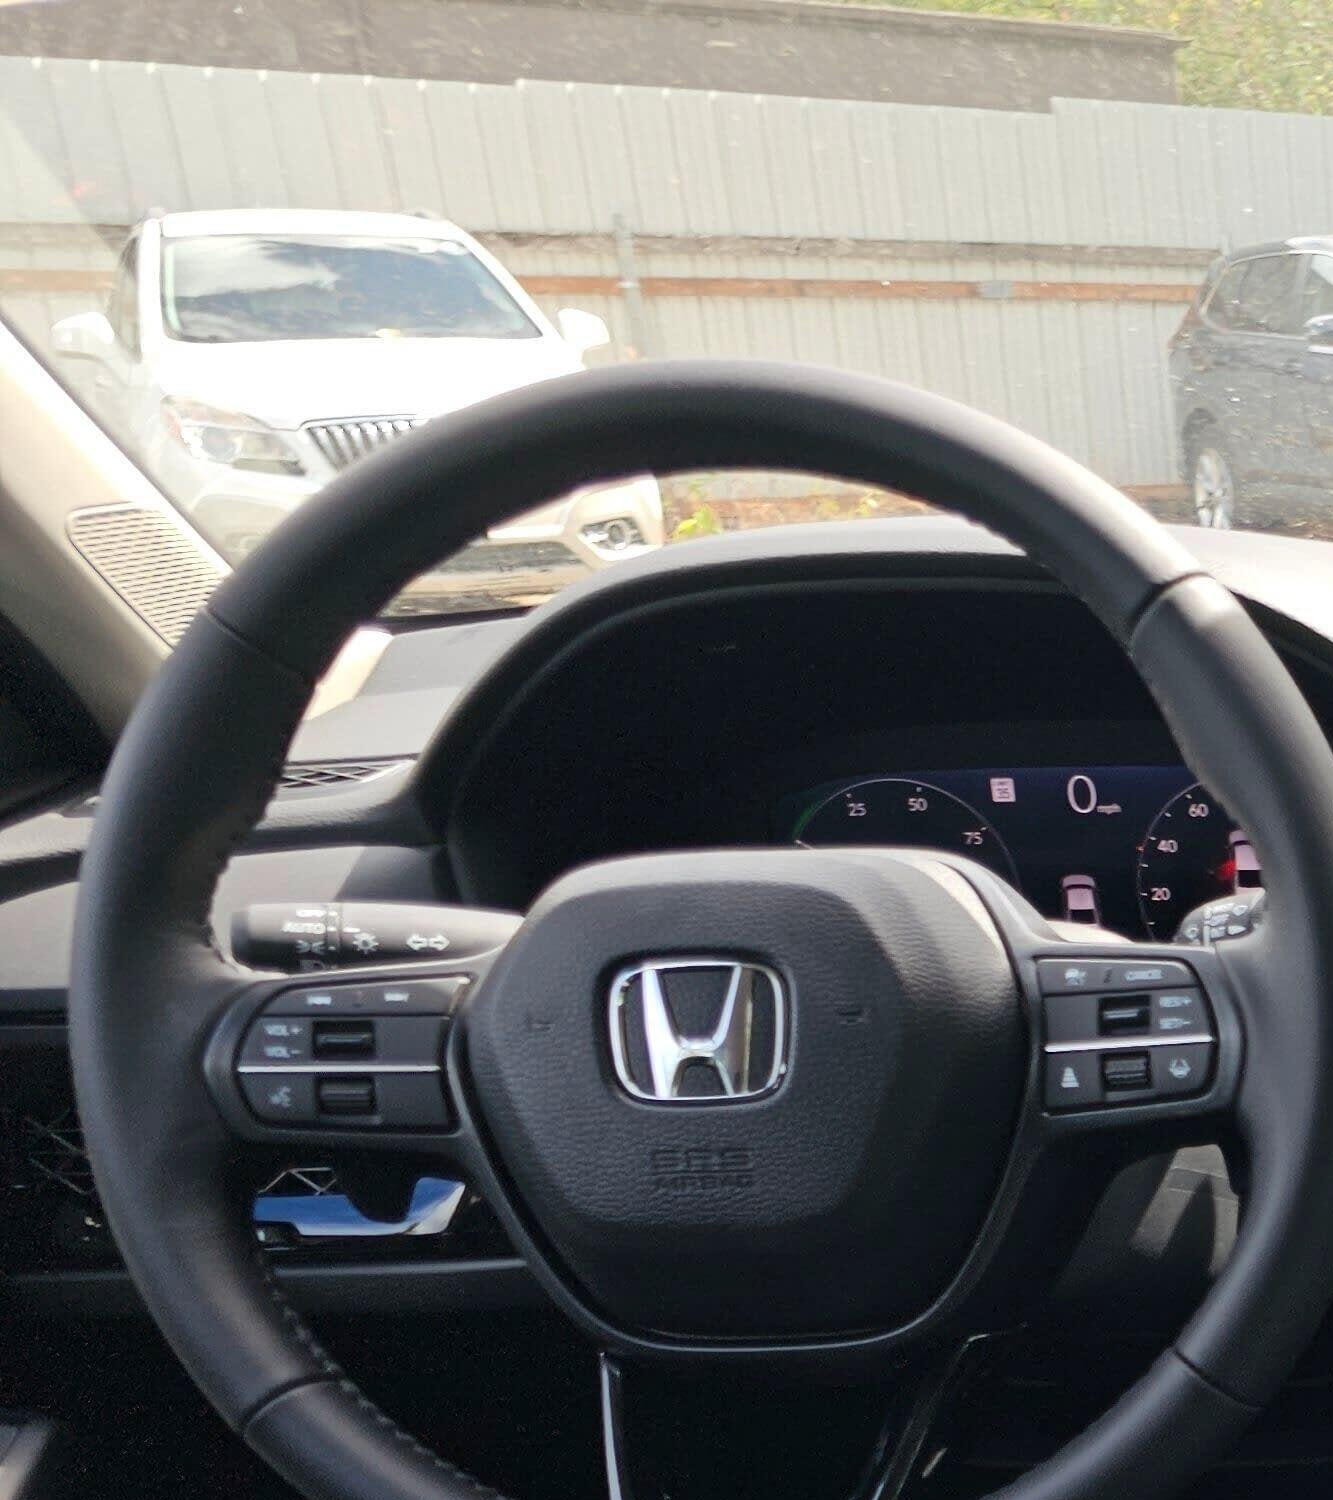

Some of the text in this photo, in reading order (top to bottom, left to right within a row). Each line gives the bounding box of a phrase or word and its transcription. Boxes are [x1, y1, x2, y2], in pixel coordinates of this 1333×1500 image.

[1066, 774, 1098, 814] 0
[847, 803, 867, 817] 25
[908, 797, 928, 812] 50
[1188, 803, 1210, 818] 60
[963, 831, 984, 846] 75
[1157, 838, 1179, 854] 40
[1151, 886, 1172, 902] 20
[282, 922, 327, 934] AUTO
